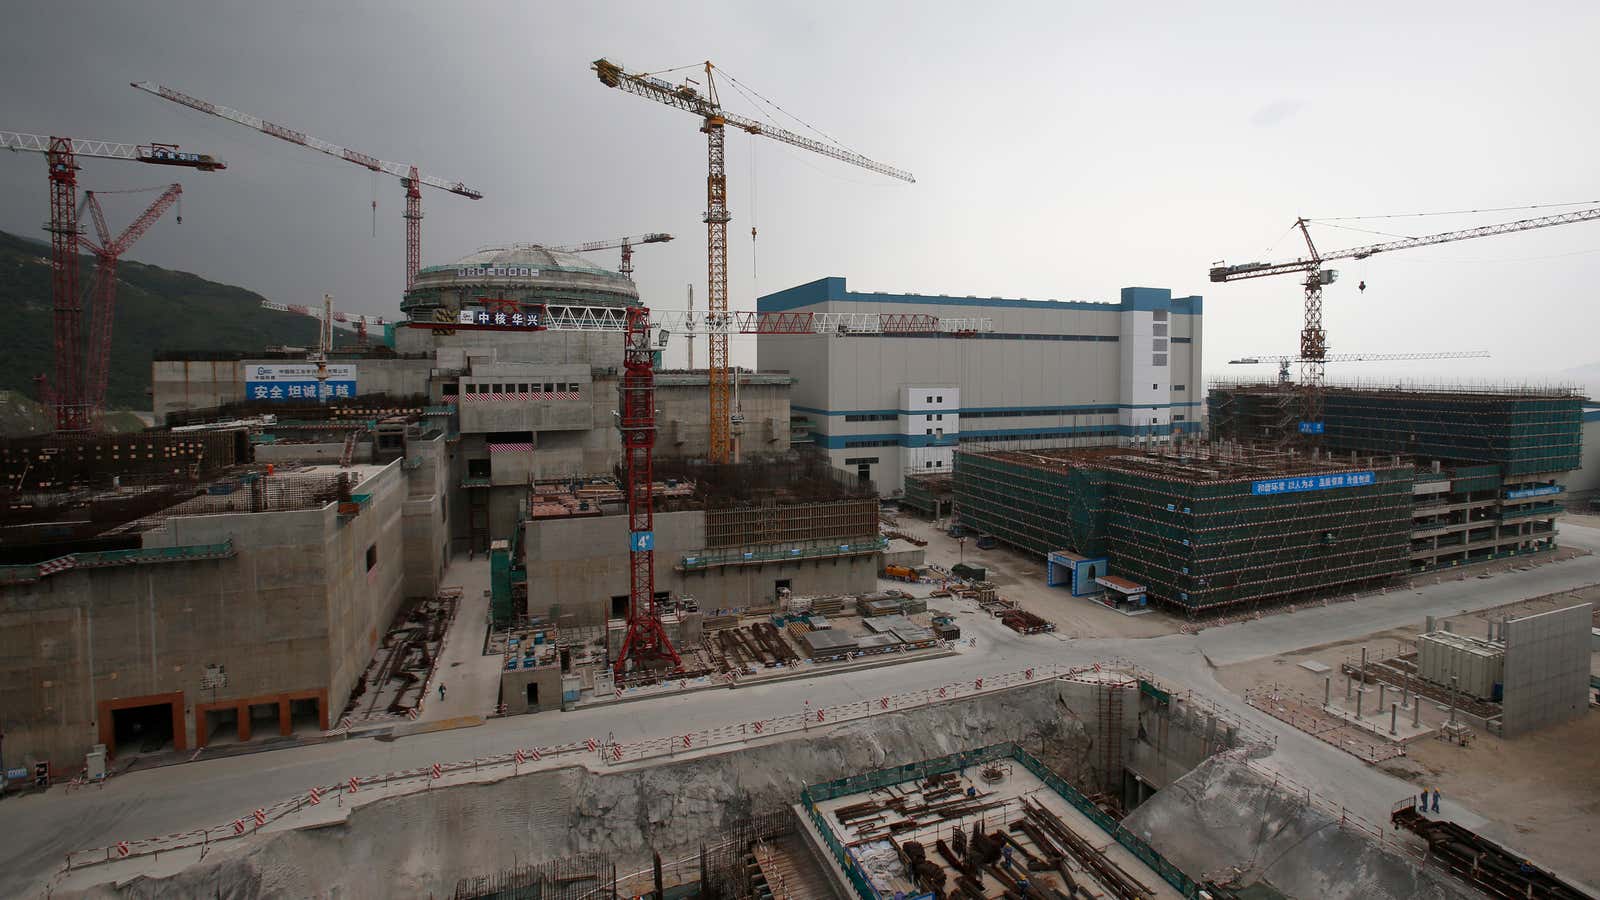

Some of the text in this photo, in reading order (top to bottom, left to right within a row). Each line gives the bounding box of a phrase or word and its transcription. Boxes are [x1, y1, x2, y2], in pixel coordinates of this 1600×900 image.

[479, 311, 538, 326] 中核华兴
[254, 385, 283, 399] 安全
[288, 384, 317, 398] 坦诚
